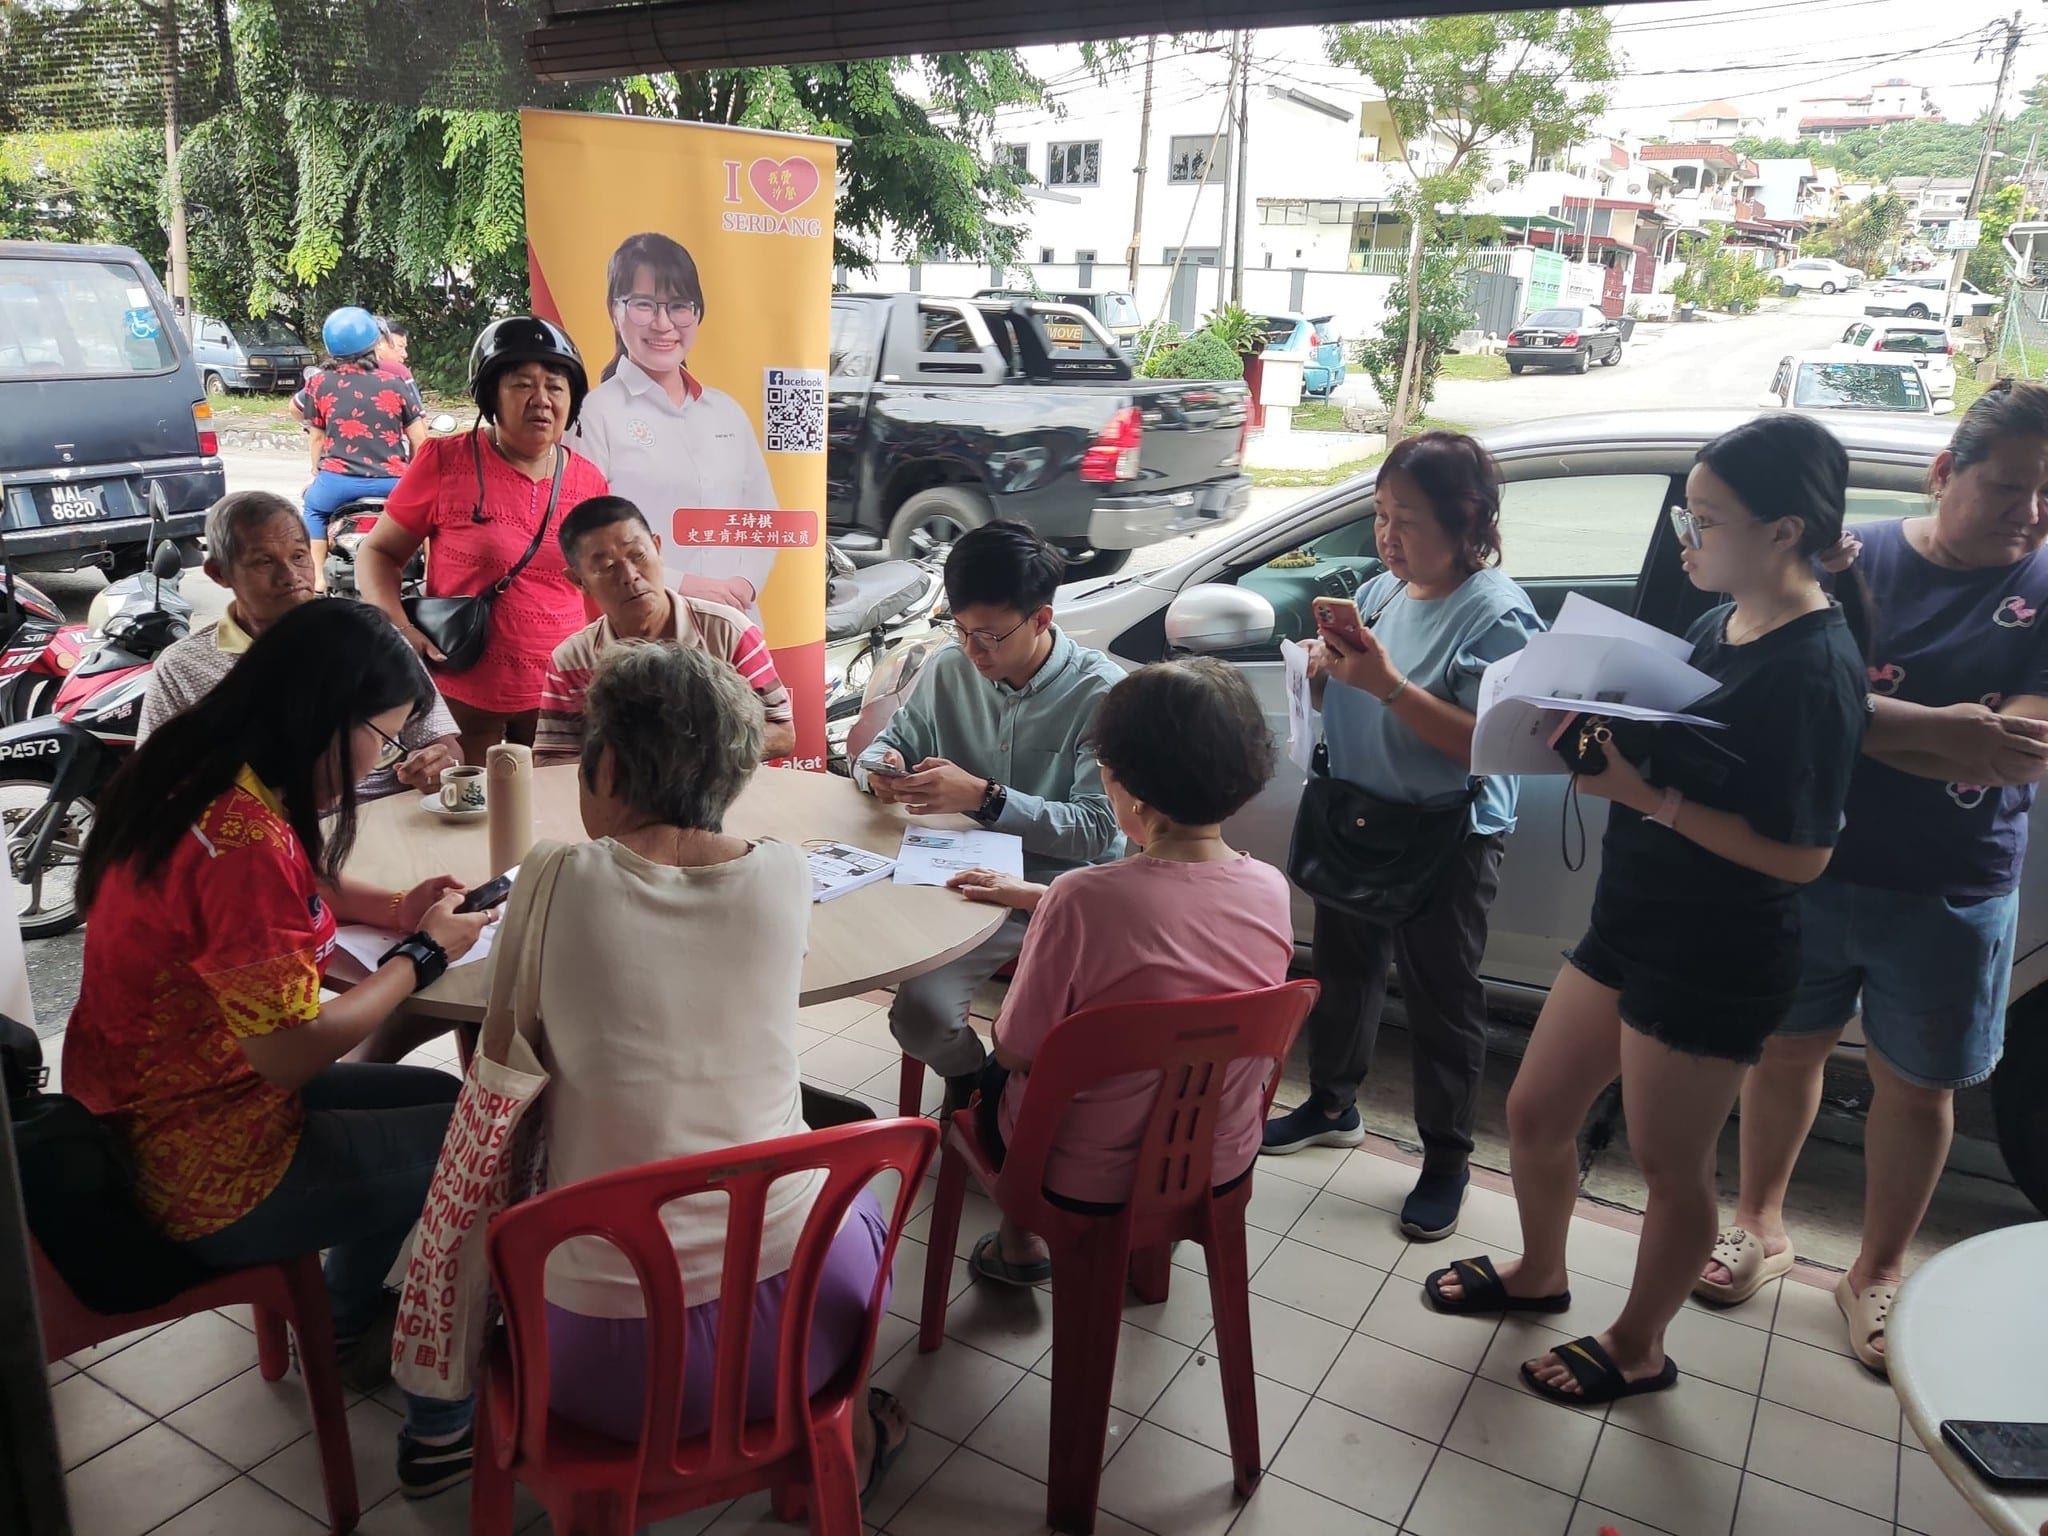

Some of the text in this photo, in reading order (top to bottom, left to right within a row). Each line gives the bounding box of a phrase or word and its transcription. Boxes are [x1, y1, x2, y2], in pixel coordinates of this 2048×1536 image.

[724, 162, 741, 203] I
[723, 212, 820, 236] SERDANG
[51, 485, 88, 503] MAL
[52, 501, 96, 520] 8620
[725, 512, 773, 529] 王诗棋
